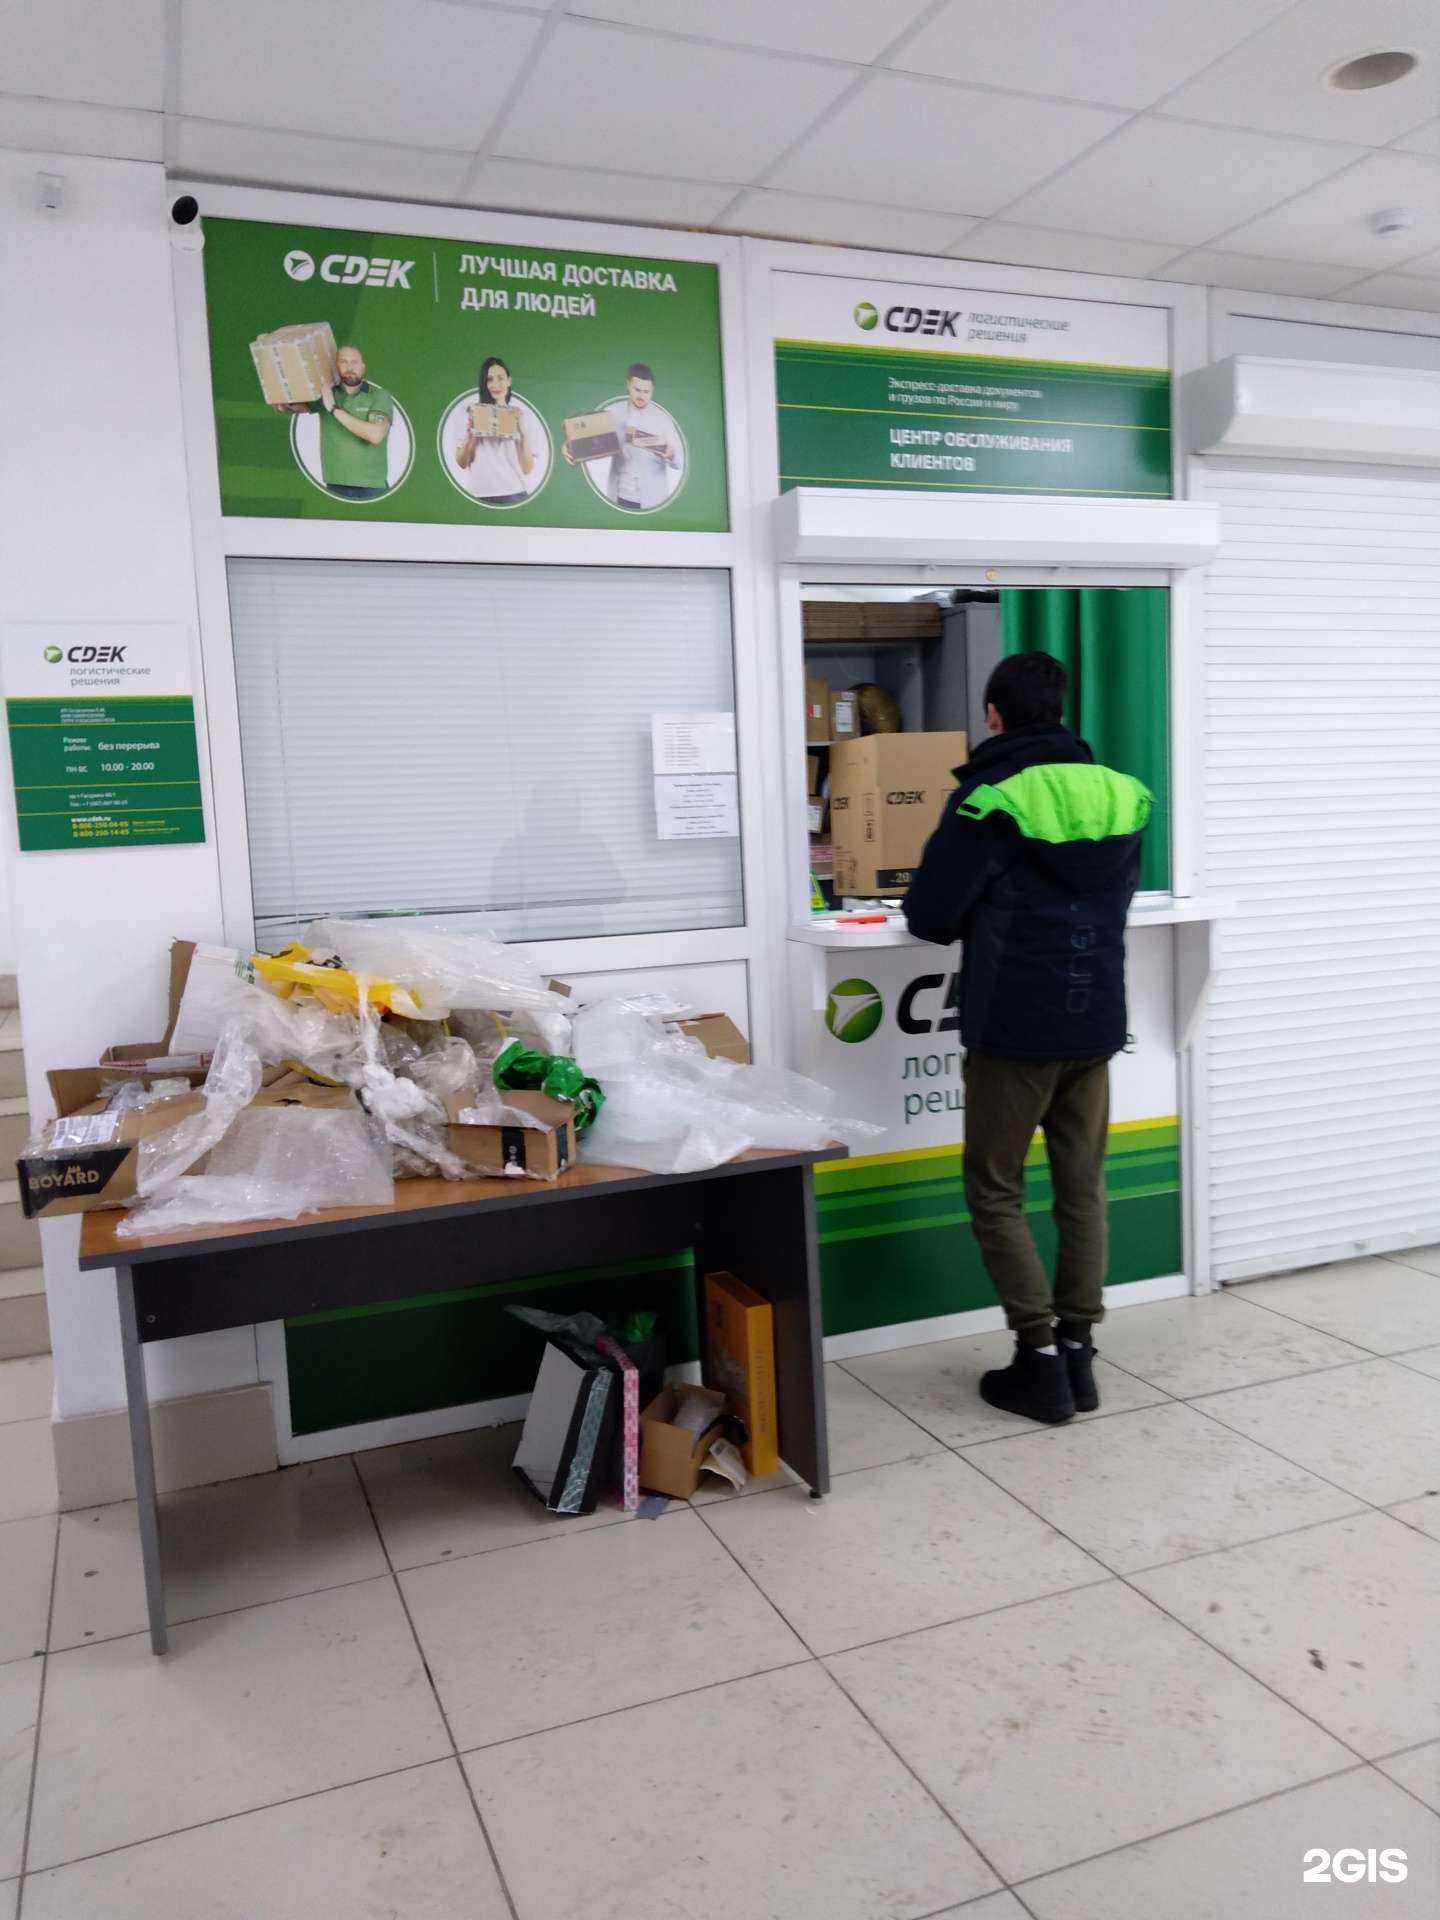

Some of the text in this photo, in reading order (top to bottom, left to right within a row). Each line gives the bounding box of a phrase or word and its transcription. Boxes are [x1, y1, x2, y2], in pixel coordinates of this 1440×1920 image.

[320, 253, 416, 289] CDEK
[459, 253, 678, 293] ЛУЧШАЯ ДОСТАВКА
[460, 287, 596, 318] ДЛЯ ЛЮДЕЙ
[885, 305, 961, 338] CDEK
[967, 310, 1071, 332] логистические
[967, 327, 1027, 344] решения
[889, 428, 1074, 453] ЦЕНТР ОБСЛУЖИВАНИЯ
[890, 452, 976, 472] КЛИЕНТОВ
[67, 646, 126, 663] CDEK
[70, 667, 152, 676] логистические
[71, 678, 121, 688] решения
[98, 742, 160, 751] без перерыва
[131, 762, 154, 771] 20.00
